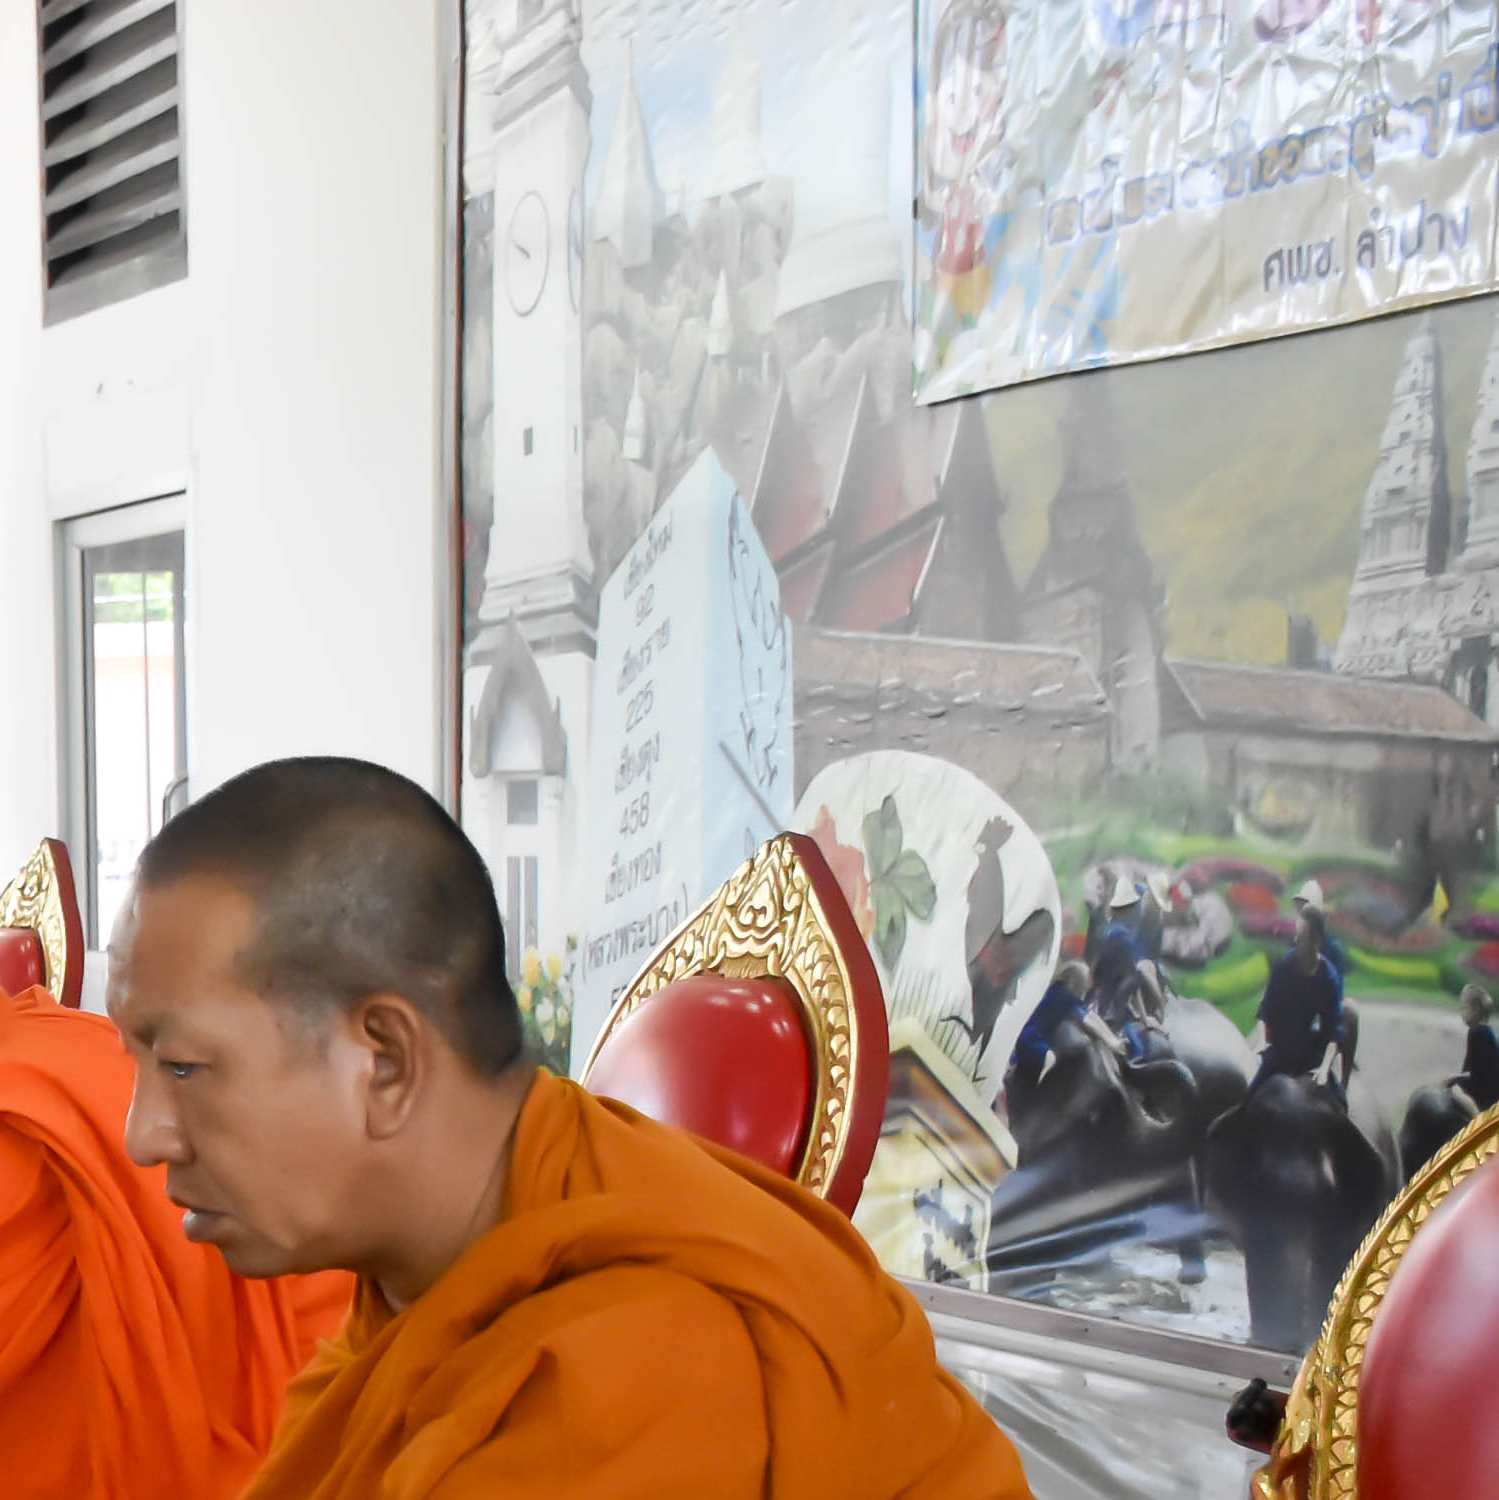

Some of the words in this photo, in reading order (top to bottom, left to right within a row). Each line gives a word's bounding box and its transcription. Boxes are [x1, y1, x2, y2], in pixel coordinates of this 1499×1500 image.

[1357, 199, 1471, 269] ลำปาง
[625, 680, 654, 732] 225
[619, 791, 651, 838] 458
